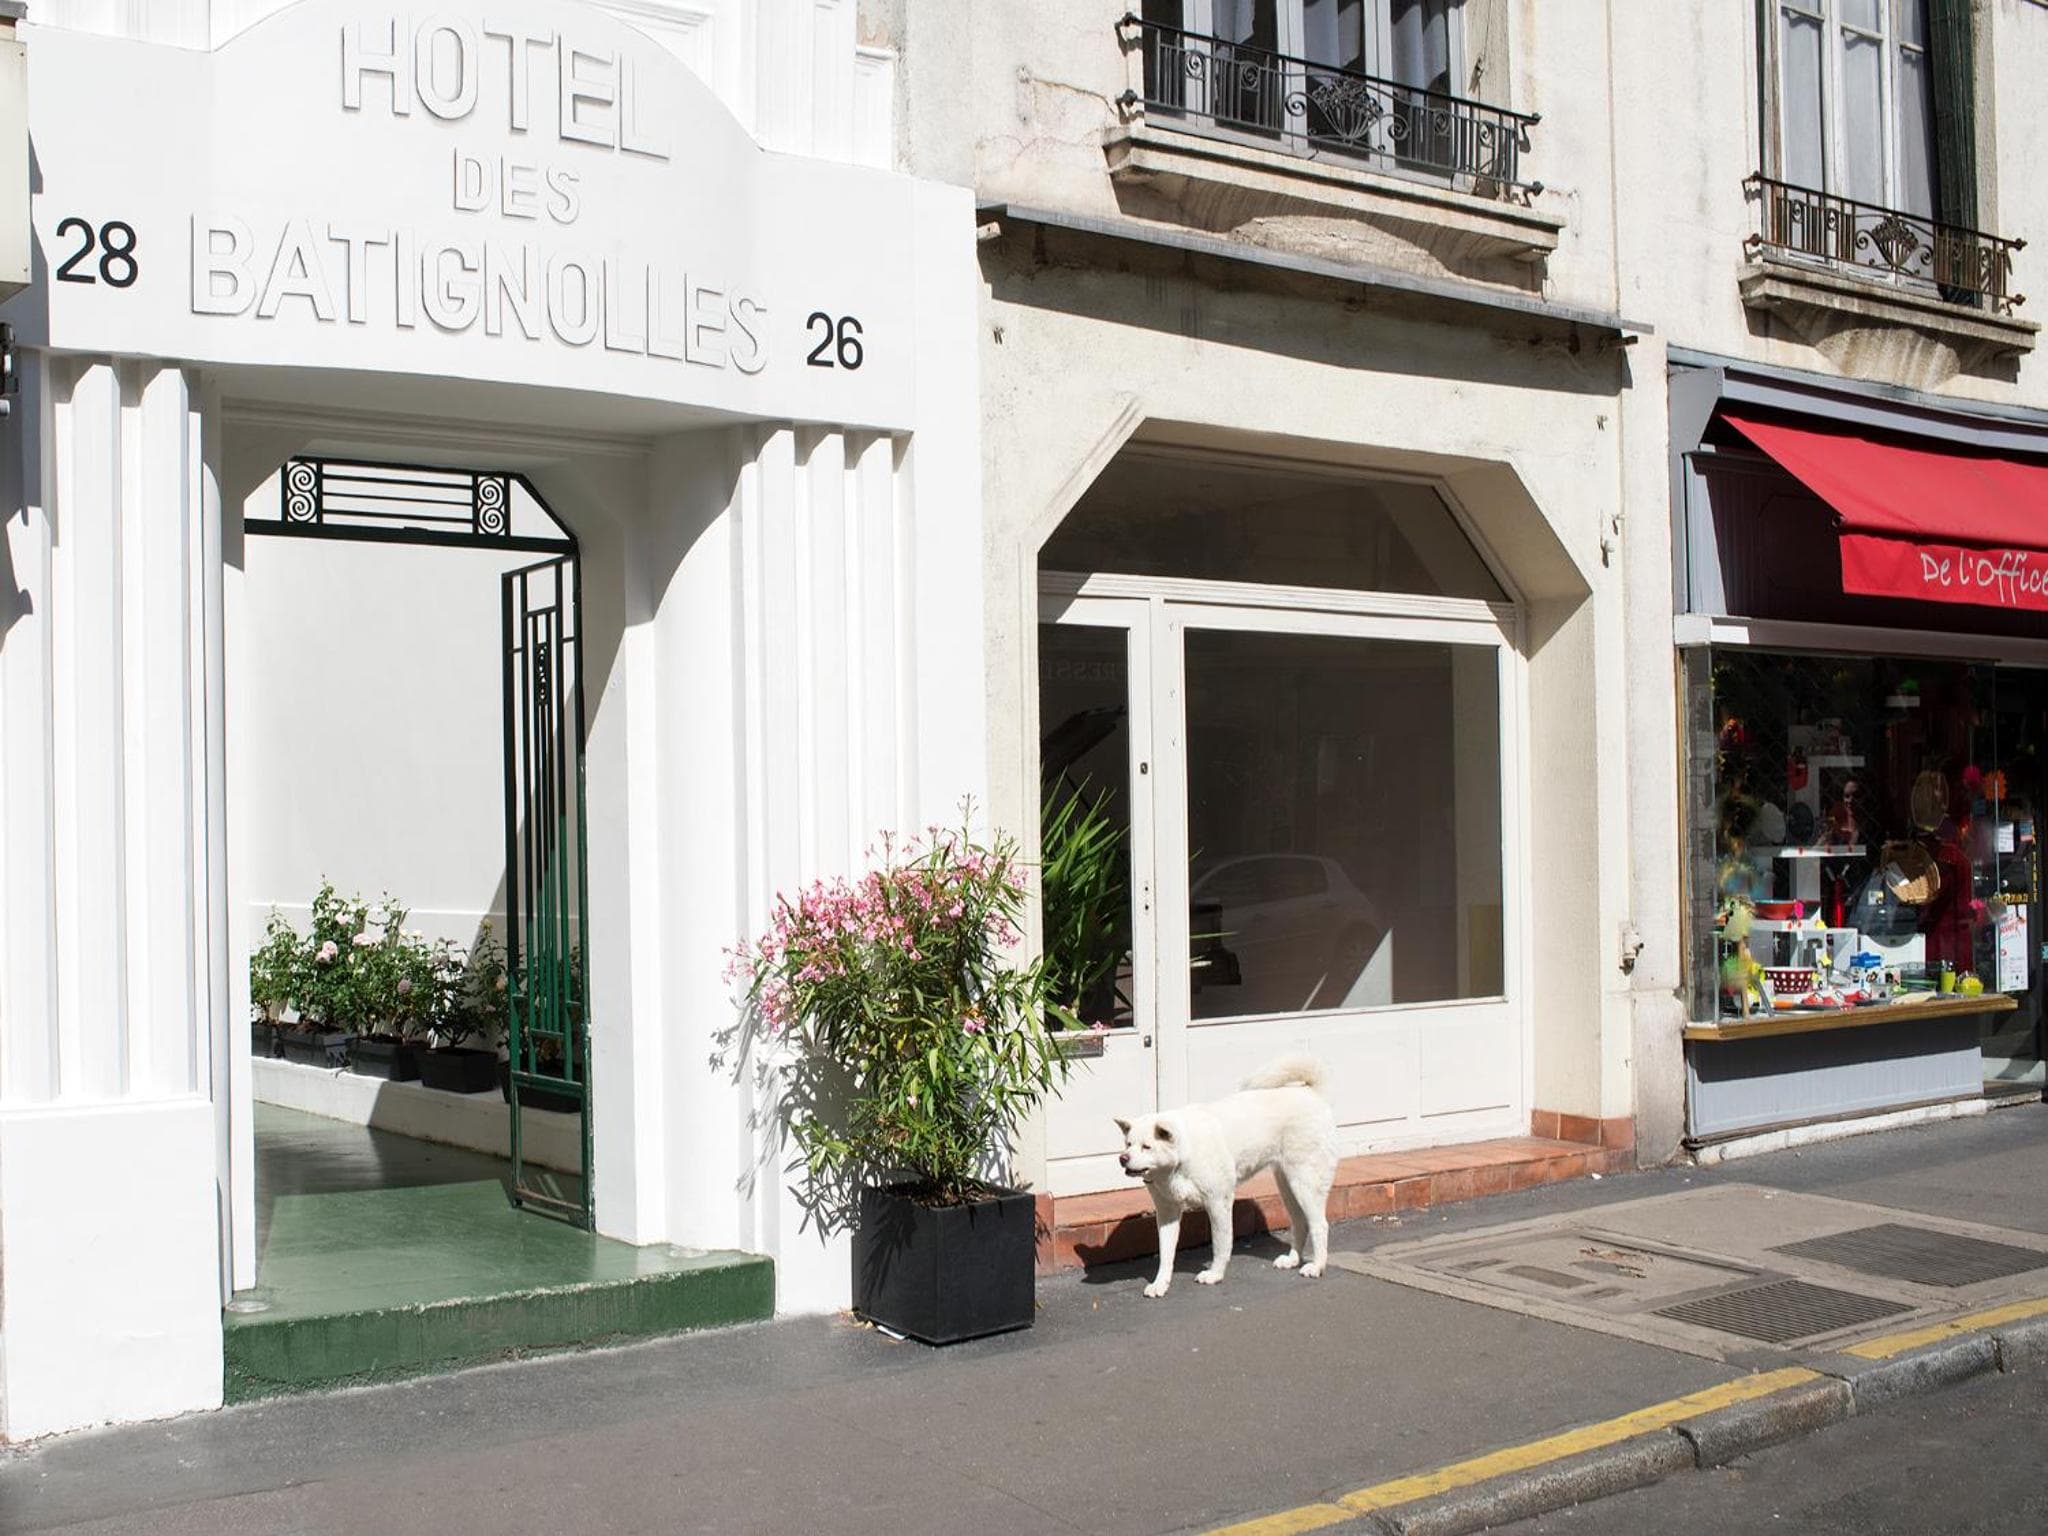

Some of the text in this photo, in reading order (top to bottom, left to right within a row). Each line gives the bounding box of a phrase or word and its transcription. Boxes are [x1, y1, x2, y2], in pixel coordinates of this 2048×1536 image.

[341, 14, 670, 161] HOTEL
[453, 146, 583, 226] DES
[55, 217, 139, 289] 28
[190, 212, 769, 376] BATIGNOLLES
[804, 311, 865, 371] 26
[1920, 551, 1952, 587] De
